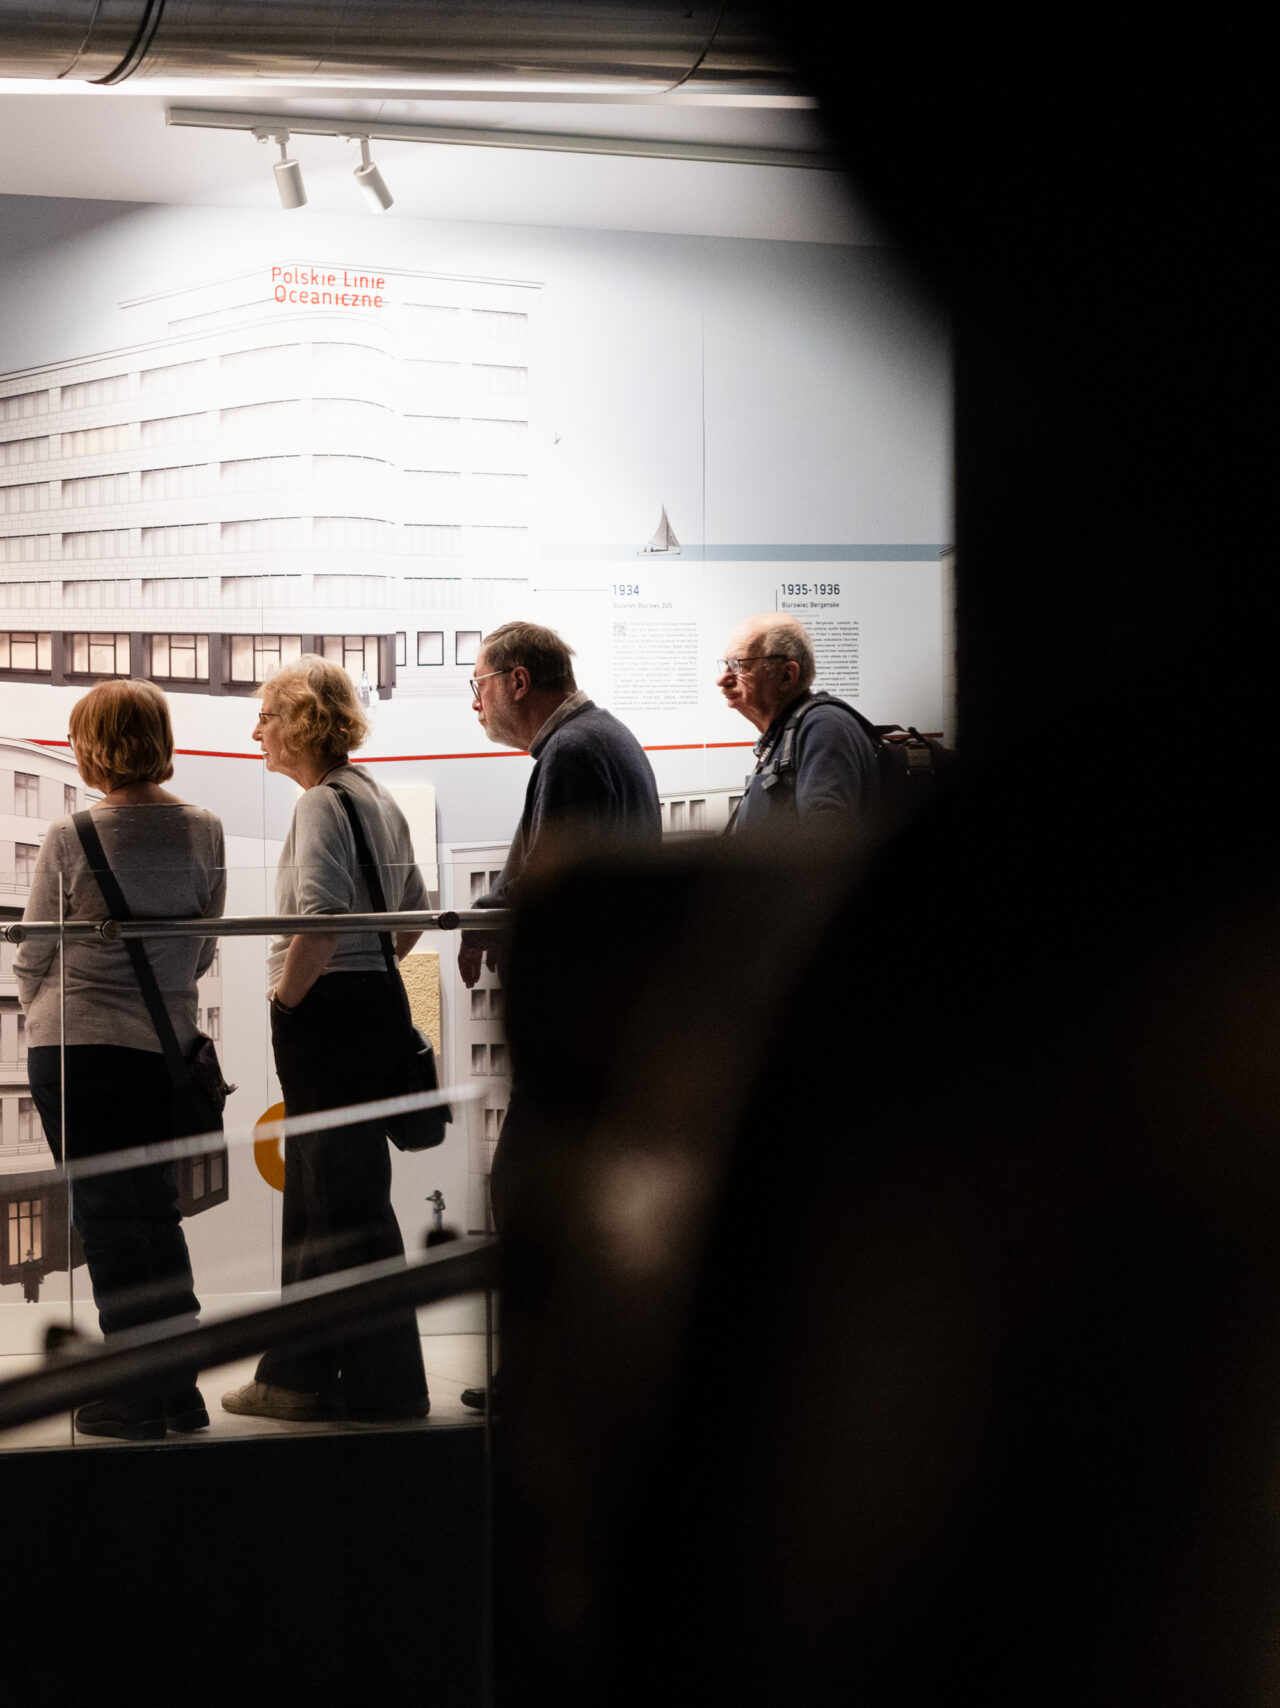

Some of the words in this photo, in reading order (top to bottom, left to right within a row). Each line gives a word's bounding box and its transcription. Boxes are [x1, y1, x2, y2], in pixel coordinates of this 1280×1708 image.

[271, 266, 336, 287] Polskie
[343, 271, 385, 290] Linie
[274, 284, 383, 308] Oceaniczne
[613, 584, 640, 596] 1934
[781, 583, 840, 596] 1935-1936
[781, 601, 809, 609] Biurowiec
[810, 601, 840, 610] Bergenske
